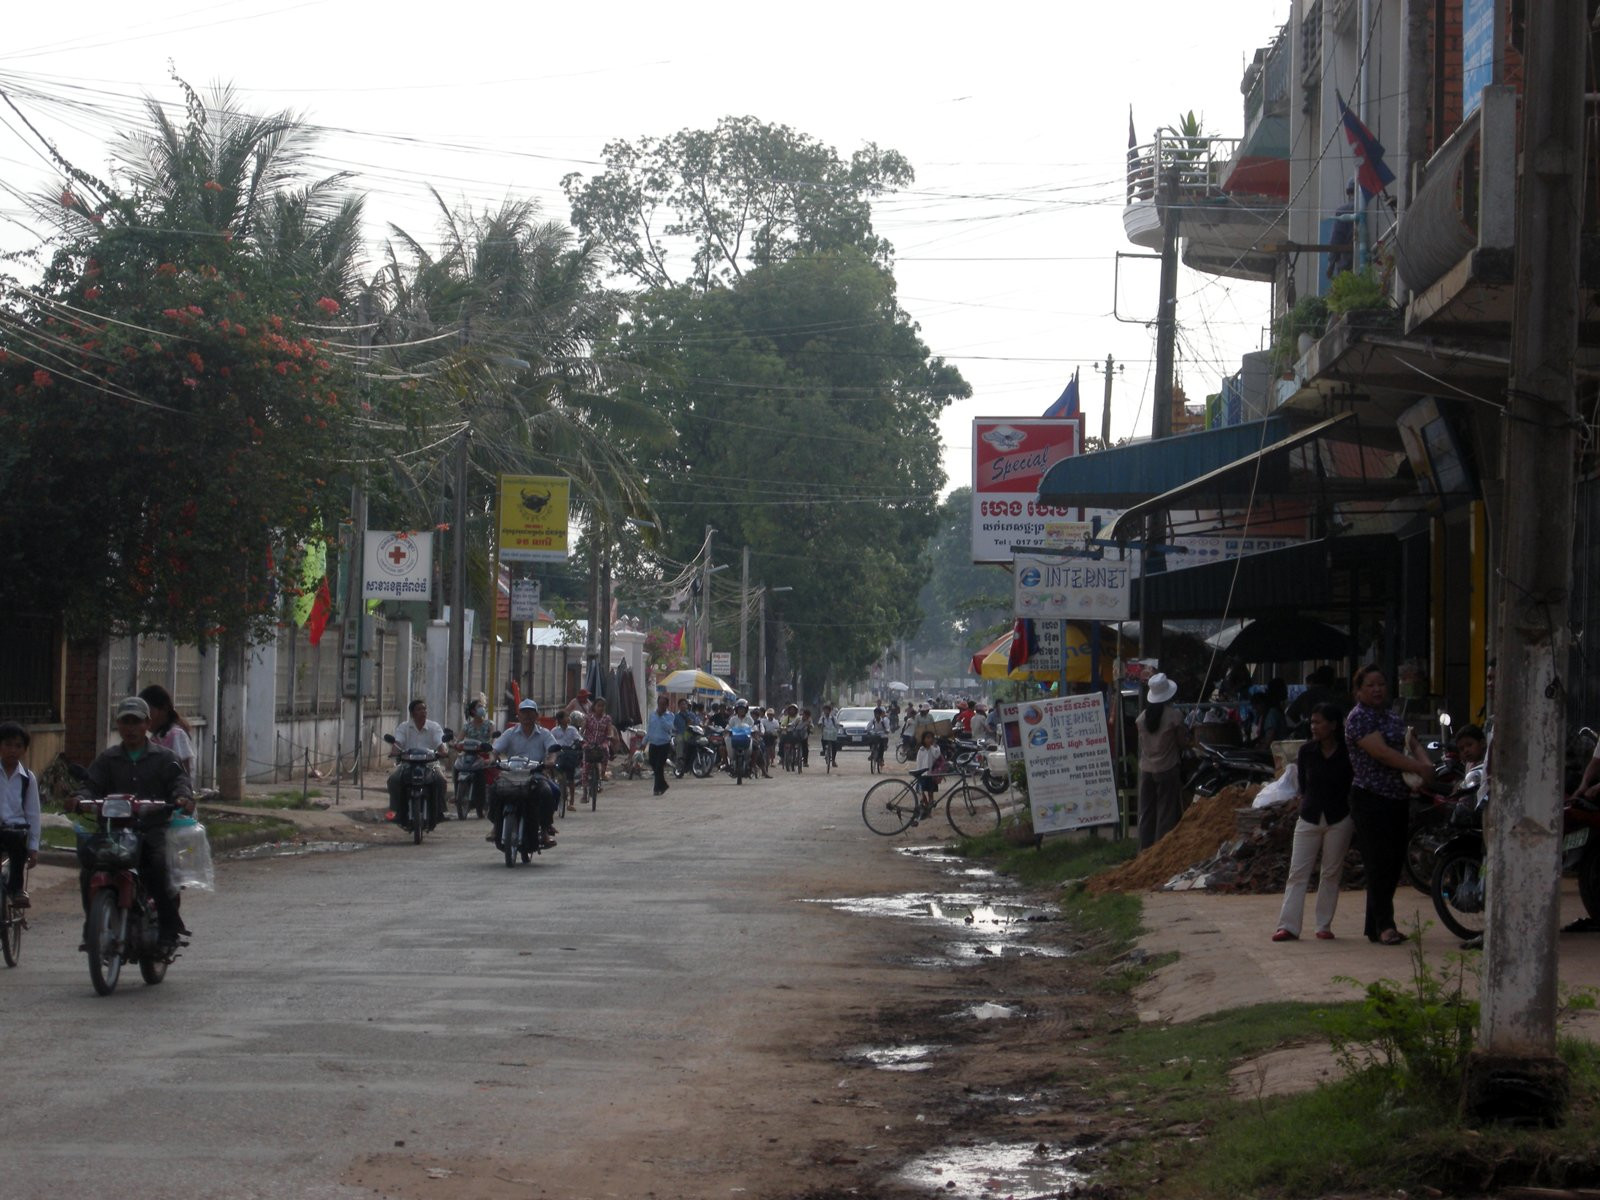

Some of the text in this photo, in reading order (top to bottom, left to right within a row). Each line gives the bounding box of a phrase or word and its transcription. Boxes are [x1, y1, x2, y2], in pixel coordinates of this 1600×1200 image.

[991, 446, 1049, 481] Special
[994, 538, 1006, 546] Tel
[1016, 538, 1031, 546] 017
[1034, 538, 1046, 546] 97
[1045, 567, 1127, 589] INTERNET
[1050, 711, 1100, 728] INTERNET
[1065, 722, 1102, 738] E-mail
[1046, 736, 1107, 751] ADSL High Speed
